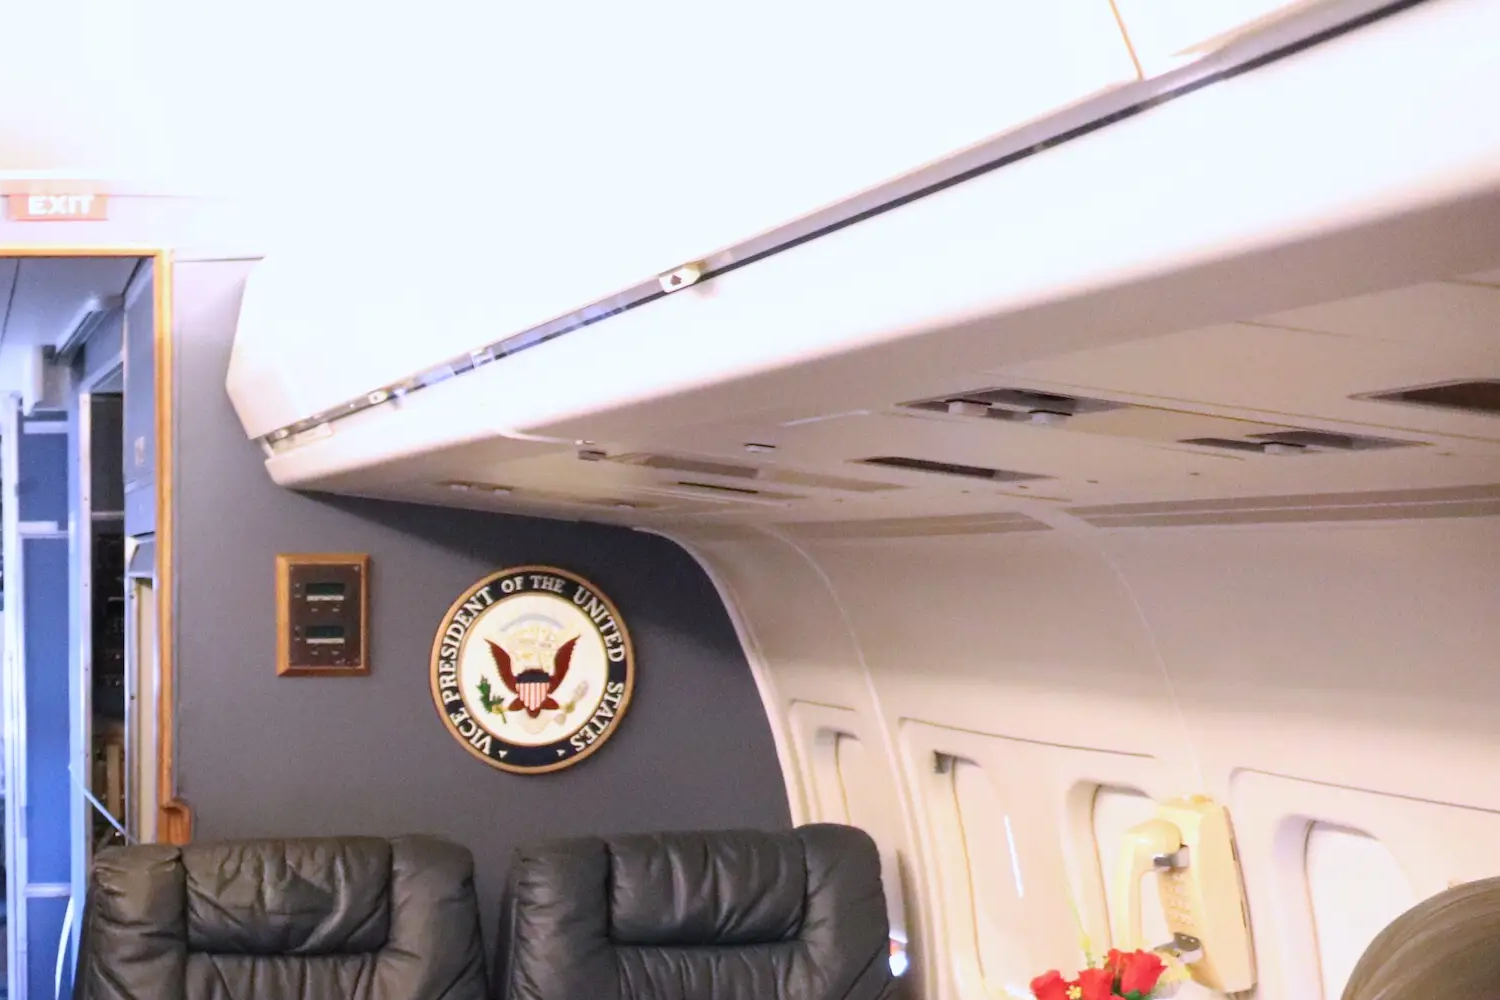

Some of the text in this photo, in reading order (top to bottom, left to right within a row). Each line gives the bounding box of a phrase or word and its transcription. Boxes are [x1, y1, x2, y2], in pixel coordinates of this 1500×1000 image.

[28, 195, 92, 215] EXIT
[438, 575, 626, 756] VICE PRESIDENT OF THE UNITED STATES
